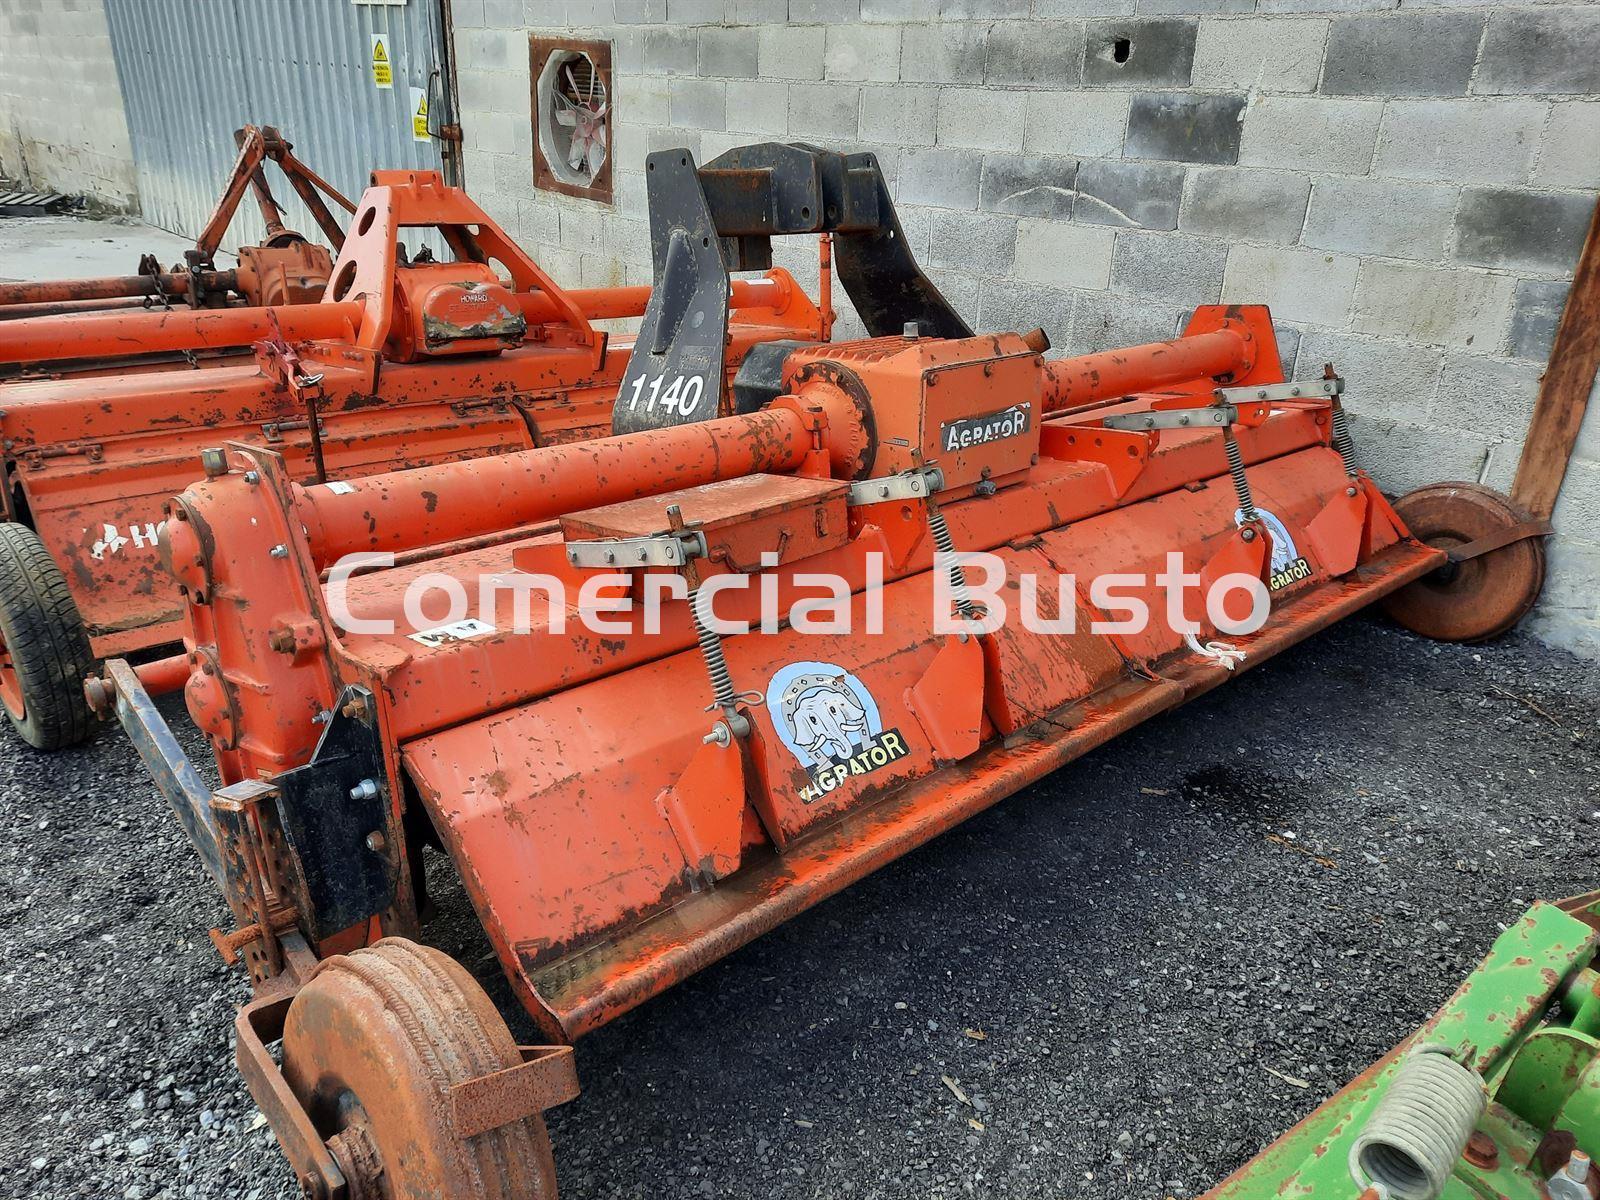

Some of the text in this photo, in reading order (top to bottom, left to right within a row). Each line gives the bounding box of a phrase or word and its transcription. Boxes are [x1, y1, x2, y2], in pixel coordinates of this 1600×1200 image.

[629, 373, 704, 416] 1140
[946, 410, 1026, 451] AGRATOR
[1270, 559, 1311, 591] GRATOR
